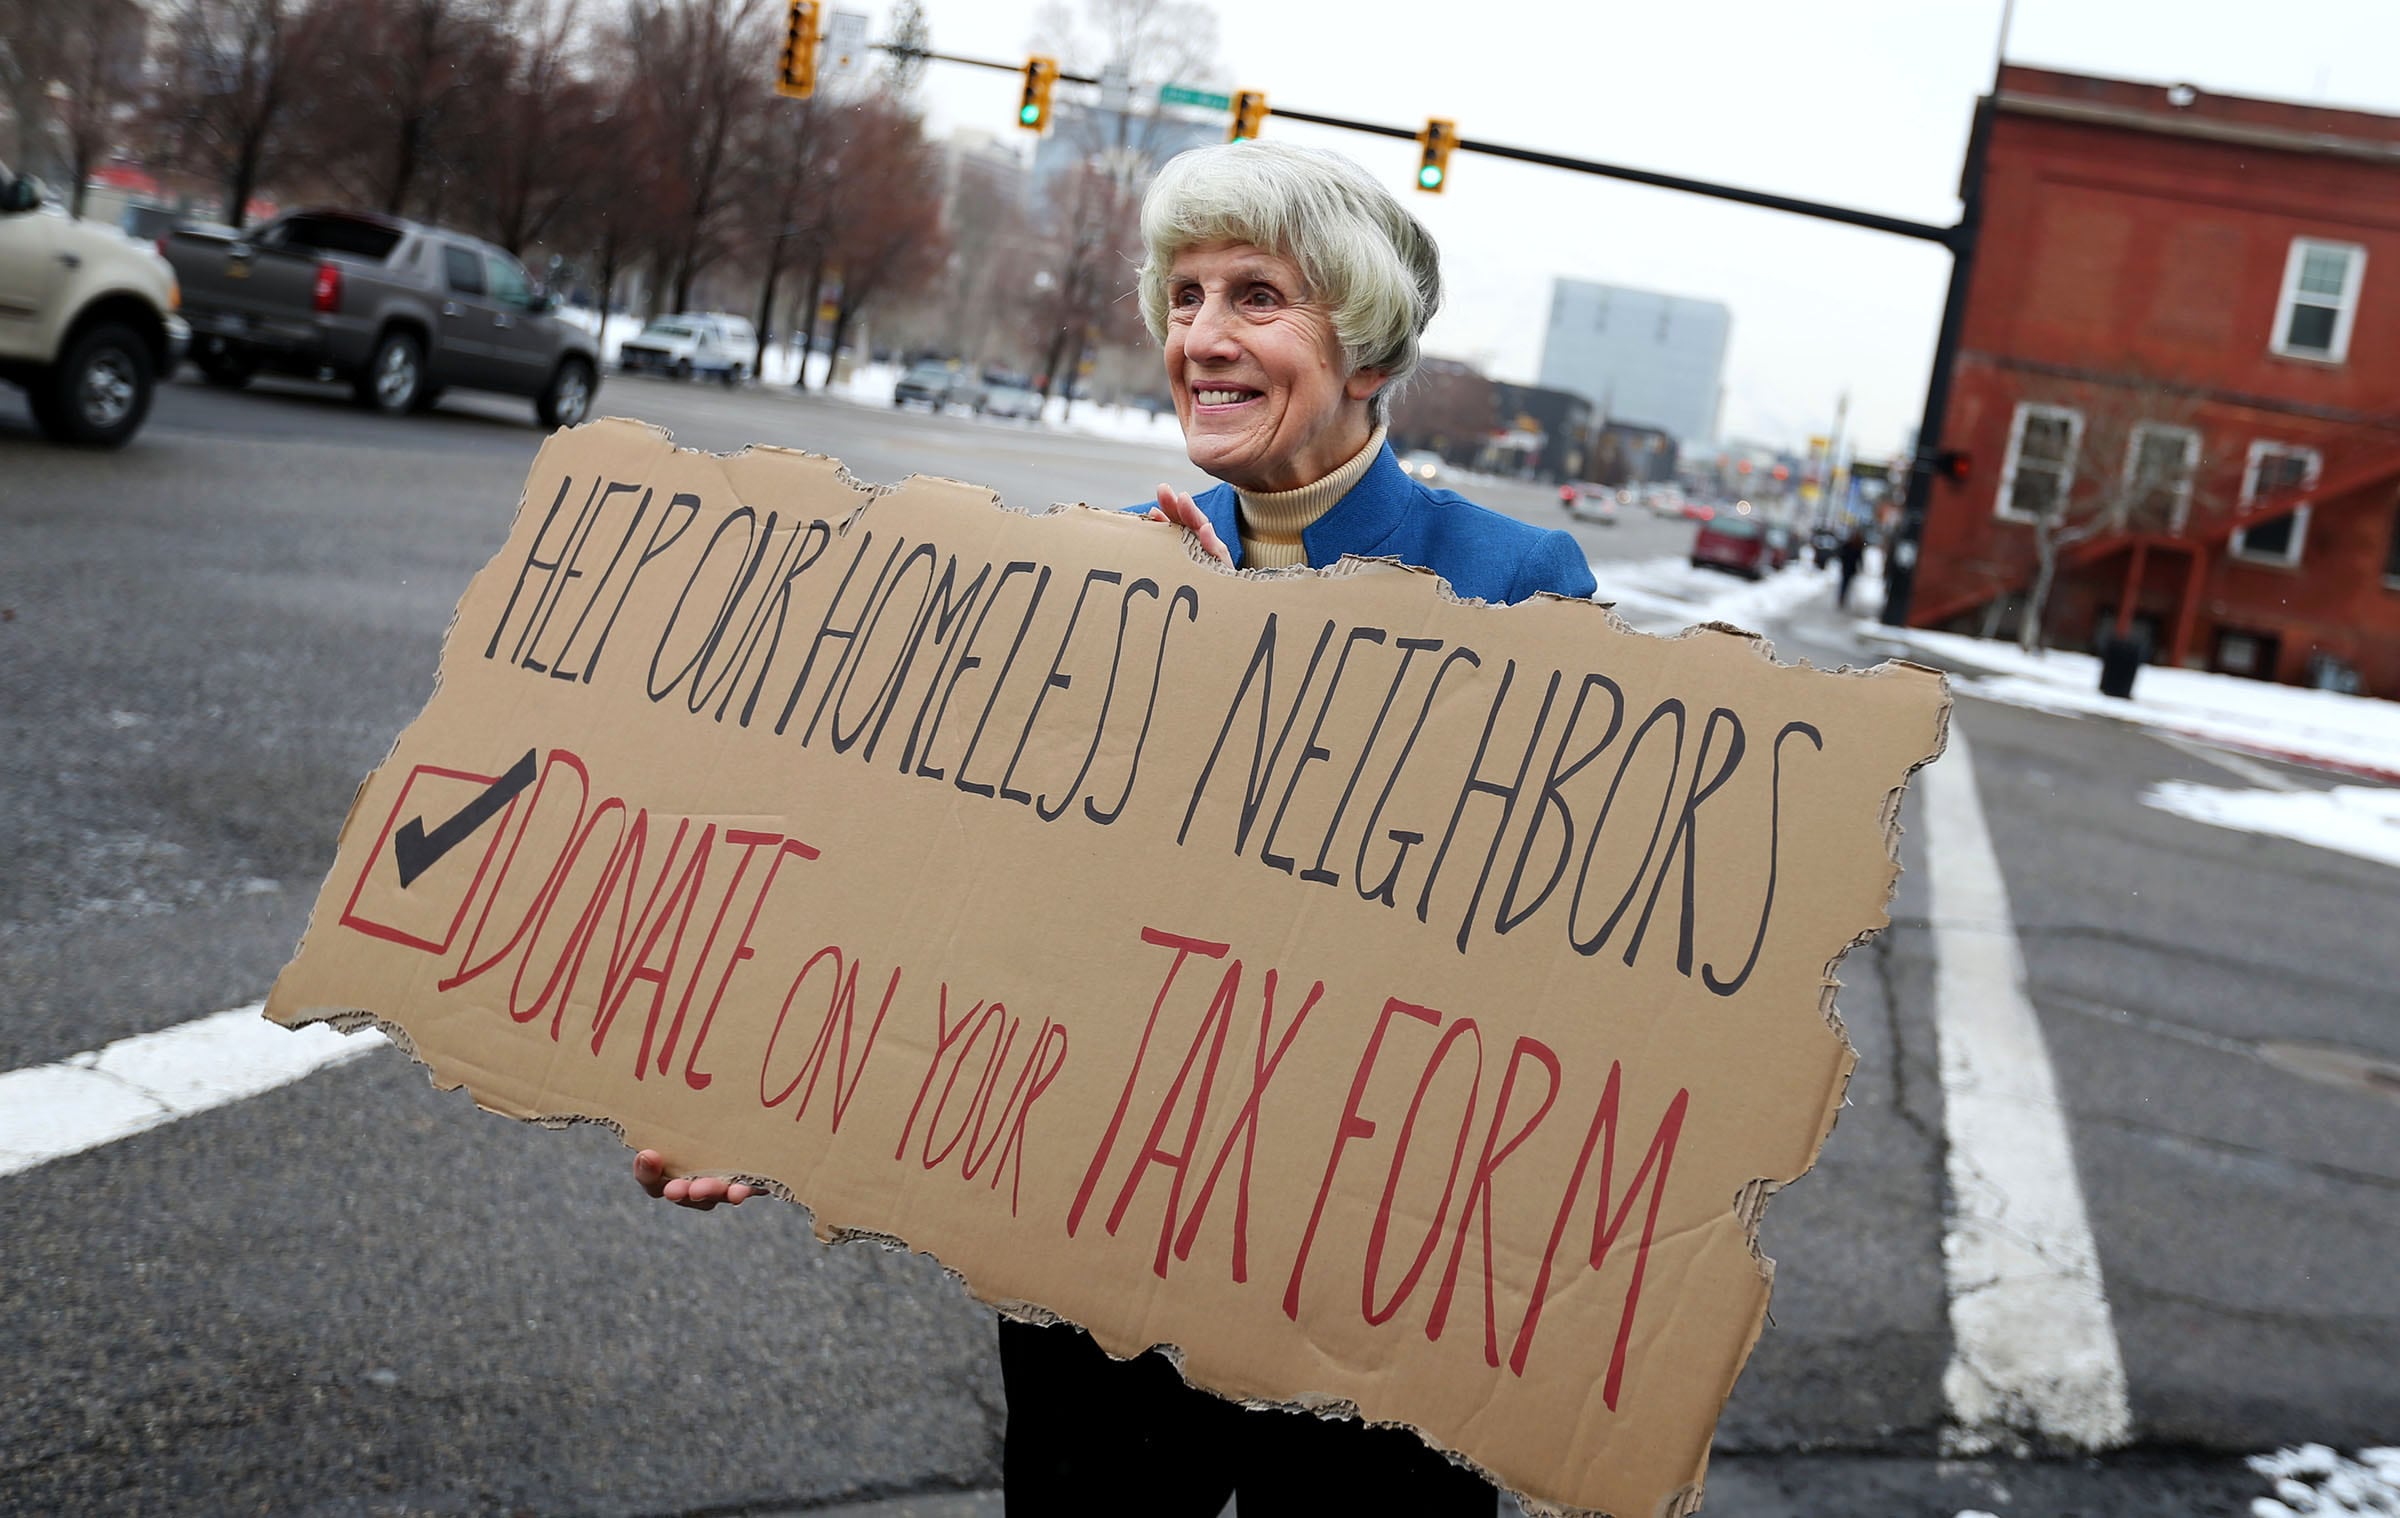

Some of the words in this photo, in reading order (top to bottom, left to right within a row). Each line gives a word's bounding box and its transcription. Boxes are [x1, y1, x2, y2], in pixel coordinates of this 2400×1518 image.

[484, 475, 701, 685] HELP
[646, 505, 831, 736] OUR
[801, 530, 1199, 826] HOMELESS
[1176, 612, 1823, 997] NEIGHBORS
[438, 748, 821, 1091] DONATE
[760, 945, 901, 1134] ON
[895, 982, 1068, 1218] YOUR
[1066, 927, 1325, 1284] TAX
[1282, 996, 1689, 1412] FORM
